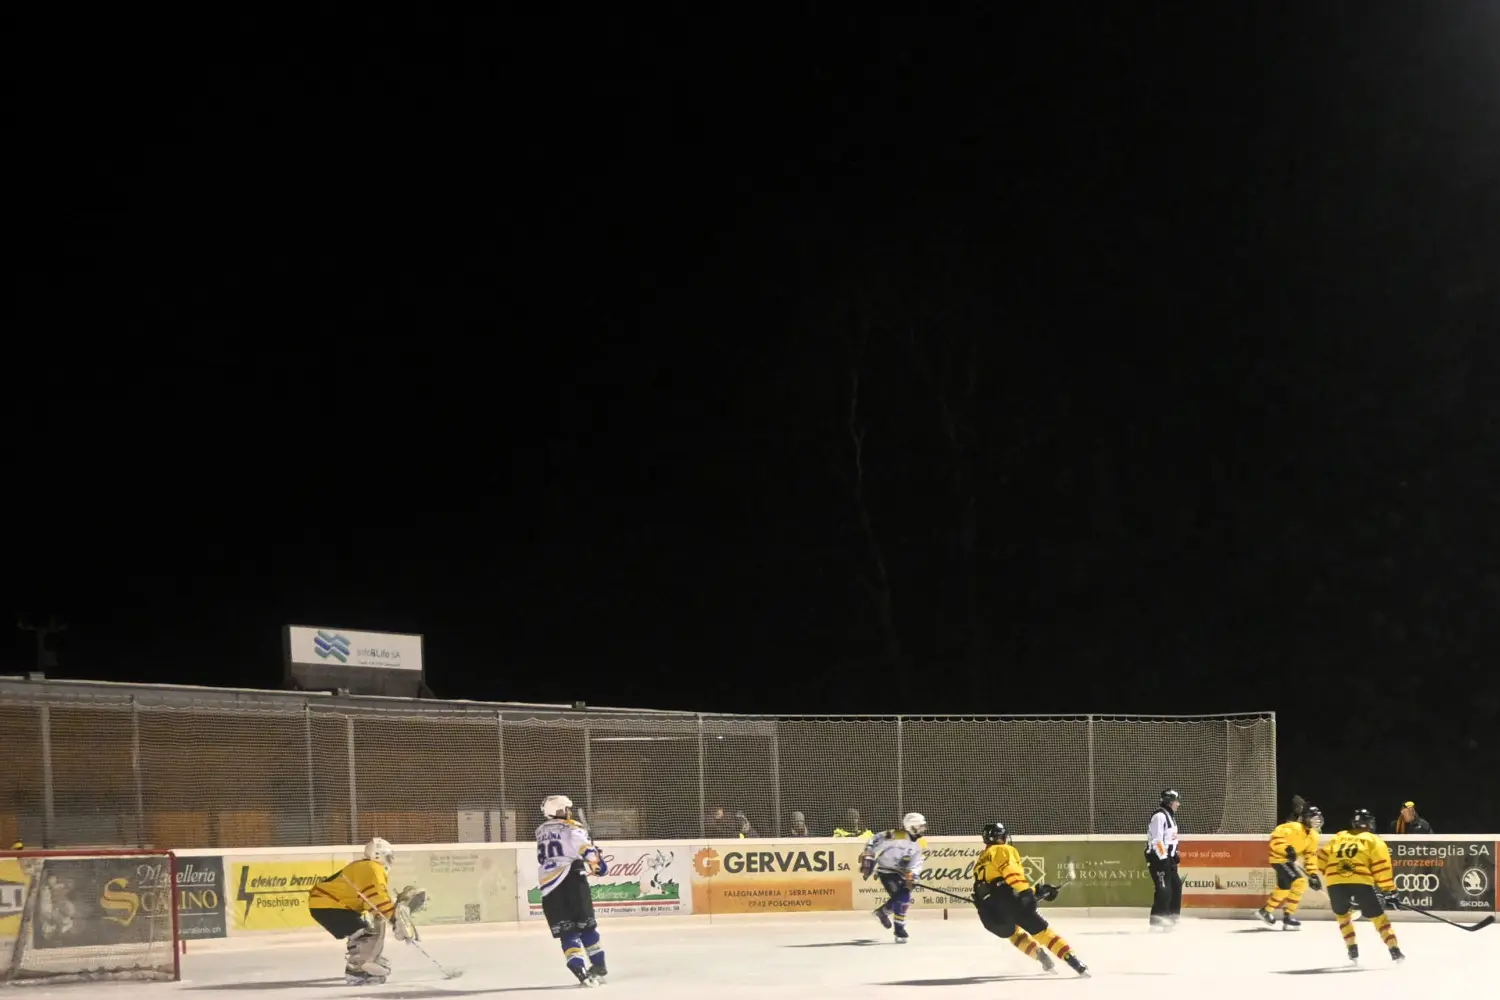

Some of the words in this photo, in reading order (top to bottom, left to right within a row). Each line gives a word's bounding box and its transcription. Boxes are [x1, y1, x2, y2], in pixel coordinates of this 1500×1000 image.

[1397, 844, 1465, 858] Battaglia
[1469, 844, 1490, 856] SA
[723, 850, 835, 874] GERVASI
[837, 862, 851, 871] SA
[1391, 859, 1445, 867] arrozzeria
[137, 864, 216, 886] Maelleria
[1079, 869, 1149, 880] ROMANTIC
[724, 889, 781, 898] FALEGNAMERIA
[789, 889, 836, 897] SERRAMENTI
[256, 896, 300, 909] Poschiavo
[768, 899, 812, 907] POSCHIAVO
[1401, 896, 1433, 907] Audi
